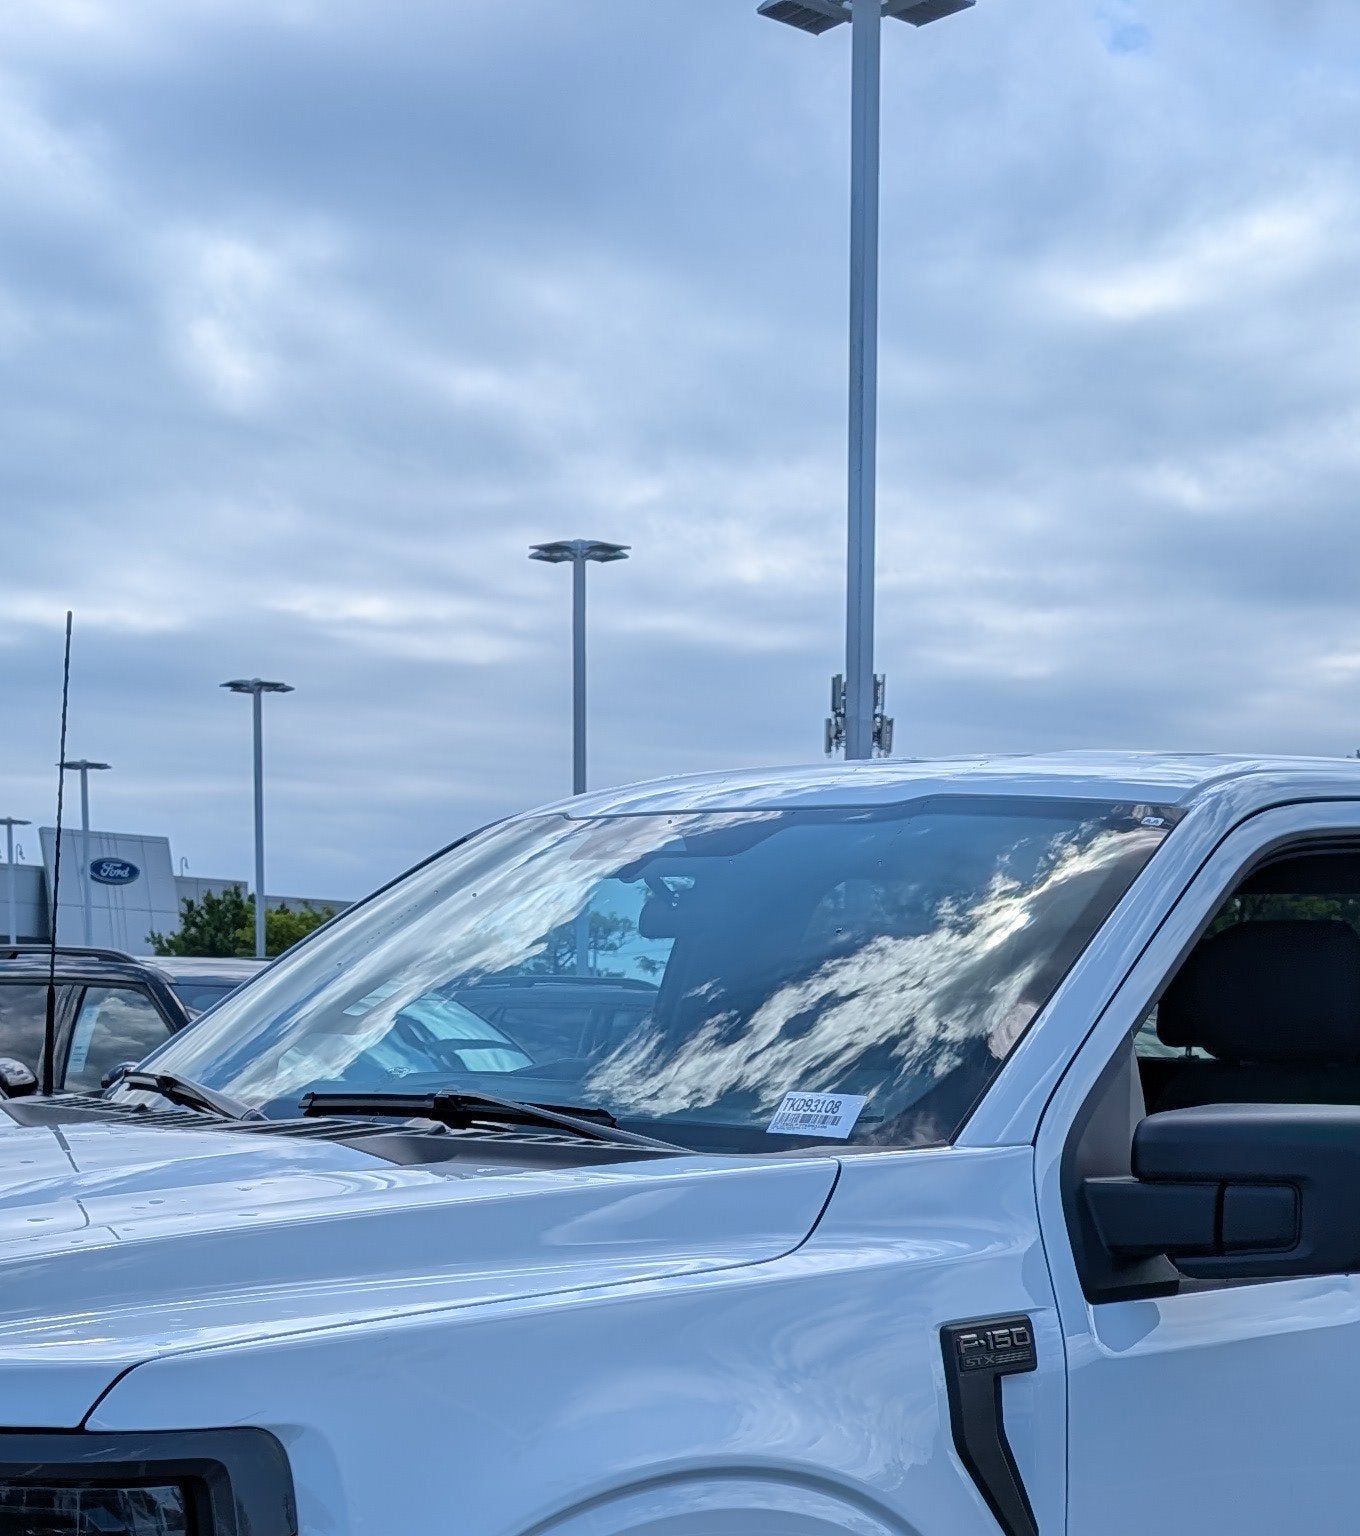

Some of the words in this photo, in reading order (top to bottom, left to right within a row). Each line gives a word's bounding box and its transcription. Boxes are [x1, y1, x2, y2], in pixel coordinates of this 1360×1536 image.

[101, 861, 130, 878] Ford
[782, 1097, 843, 1115] TKD93108
[957, 1327, 1031, 1354] F-150
[965, 1353, 995, 1367] STX
